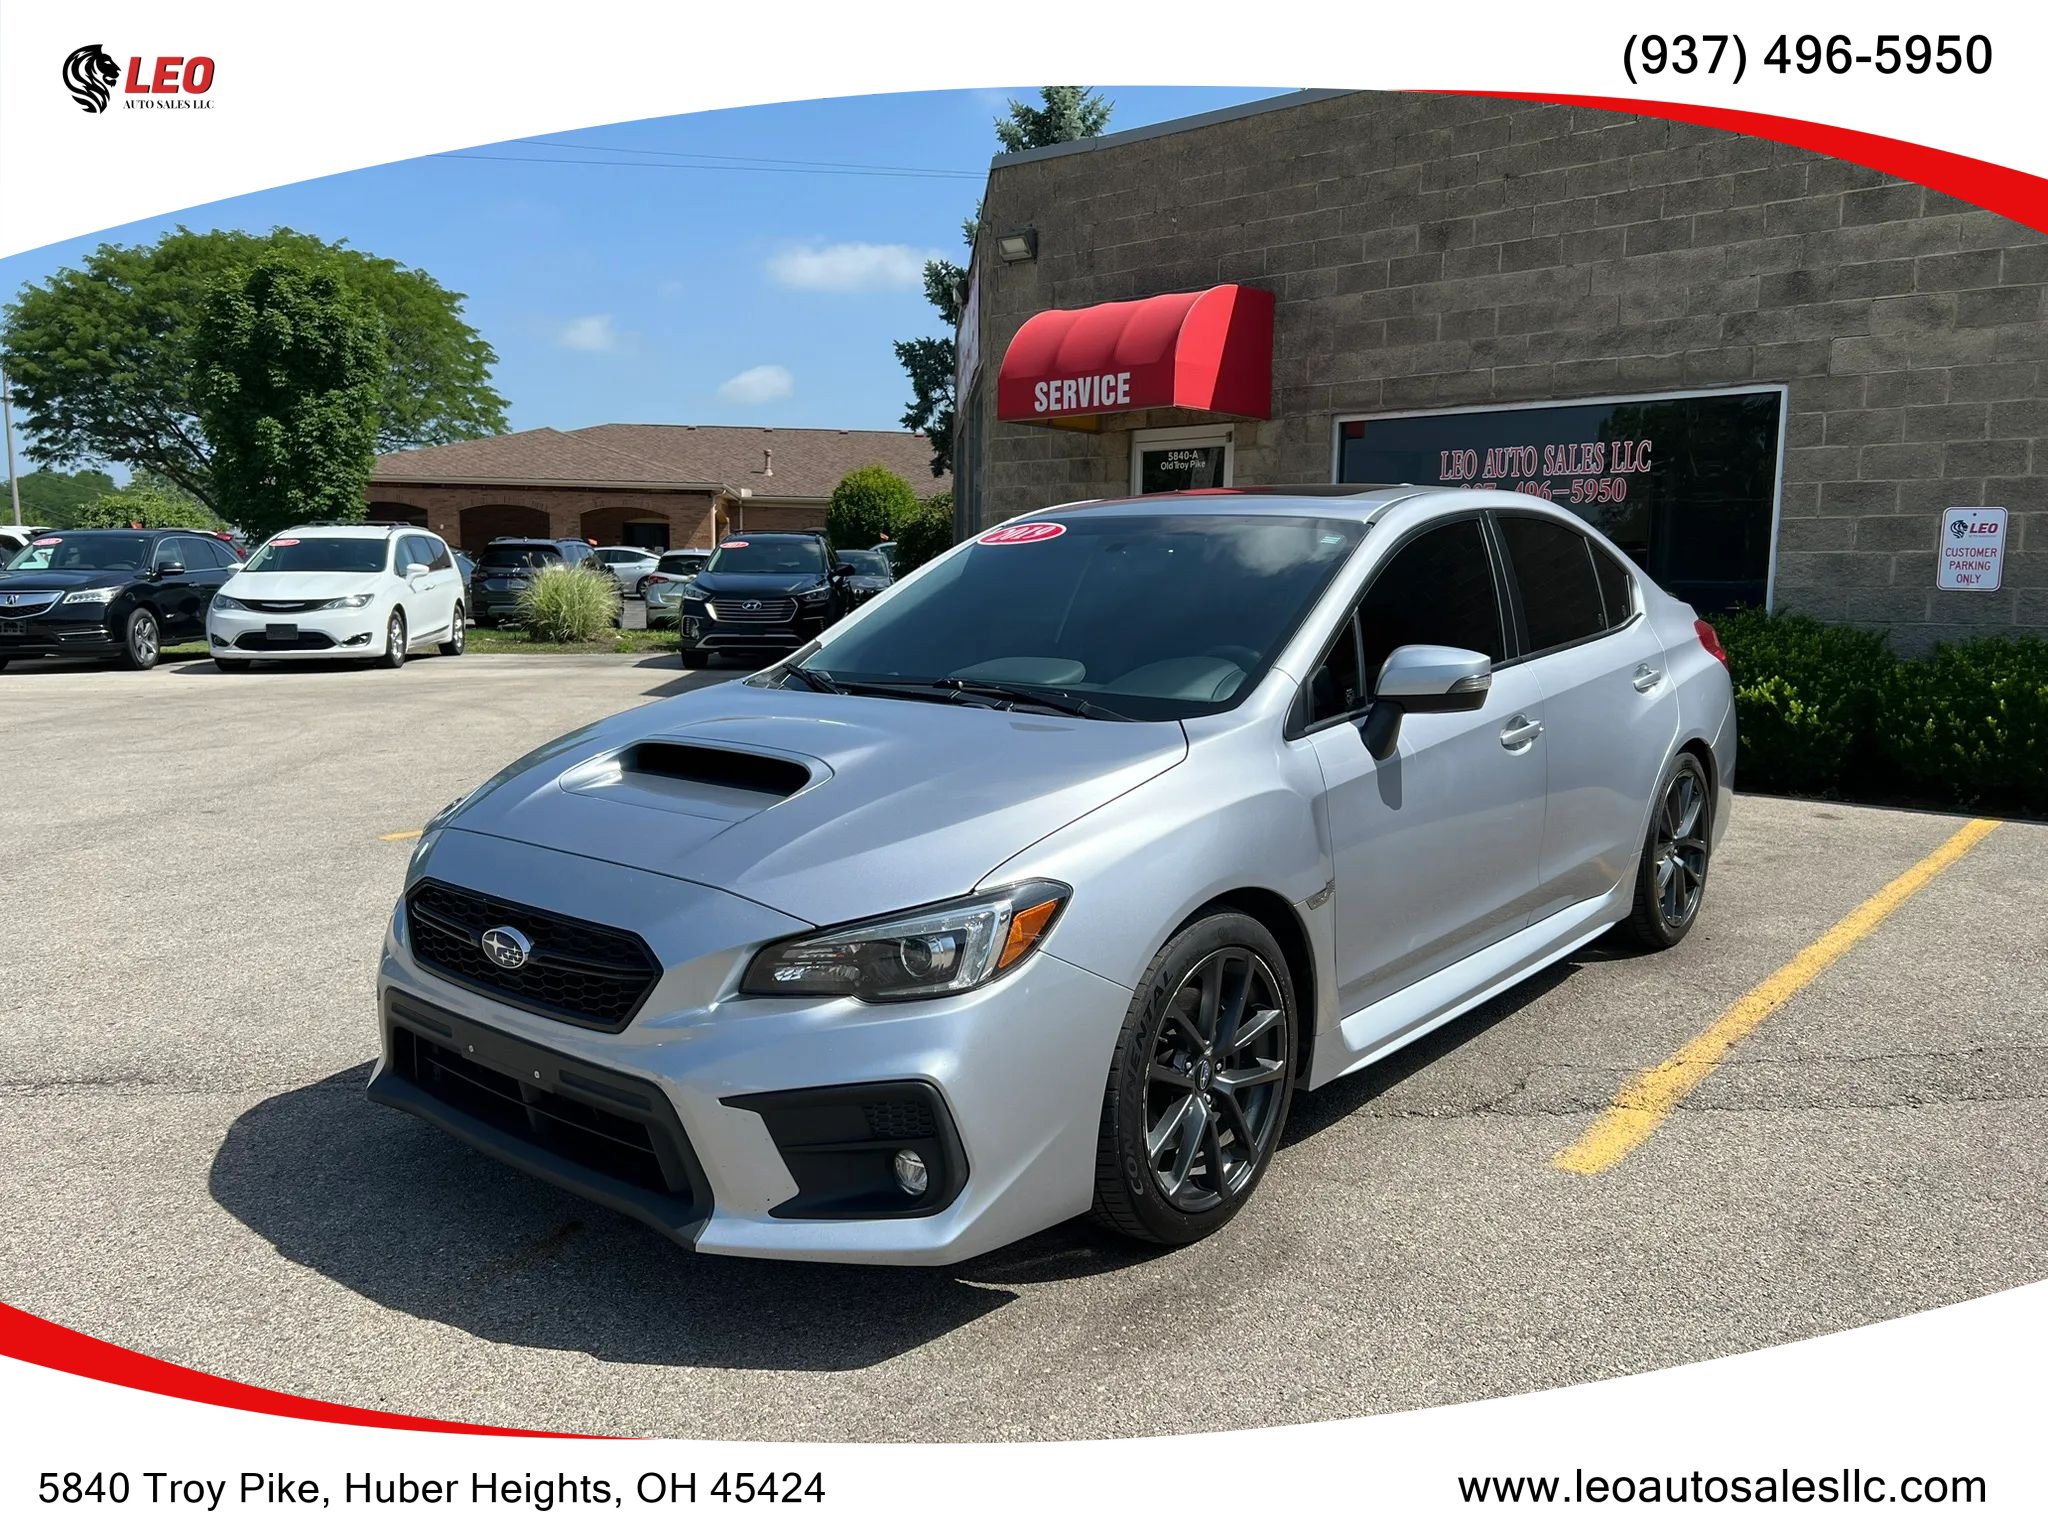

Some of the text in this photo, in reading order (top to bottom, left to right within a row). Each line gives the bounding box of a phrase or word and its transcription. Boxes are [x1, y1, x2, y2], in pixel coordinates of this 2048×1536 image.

[1034, 372, 1130, 412] SERVICE
[1168, 450, 1198, 461] 5840-A
[1440, 440, 1651, 480] LEO AUTO SALES LLC
[1161, 460, 1206, 471] Old Troy Pike
[1969, 523, 1998, 533] LEO
[1945, 547, 1998, 557] CUSTOMER
[1949, 560, 1991, 571] PARKING
[1956, 574, 1981, 583] ONLY
[1123, 969, 1174, 1196] CONINENTAL
